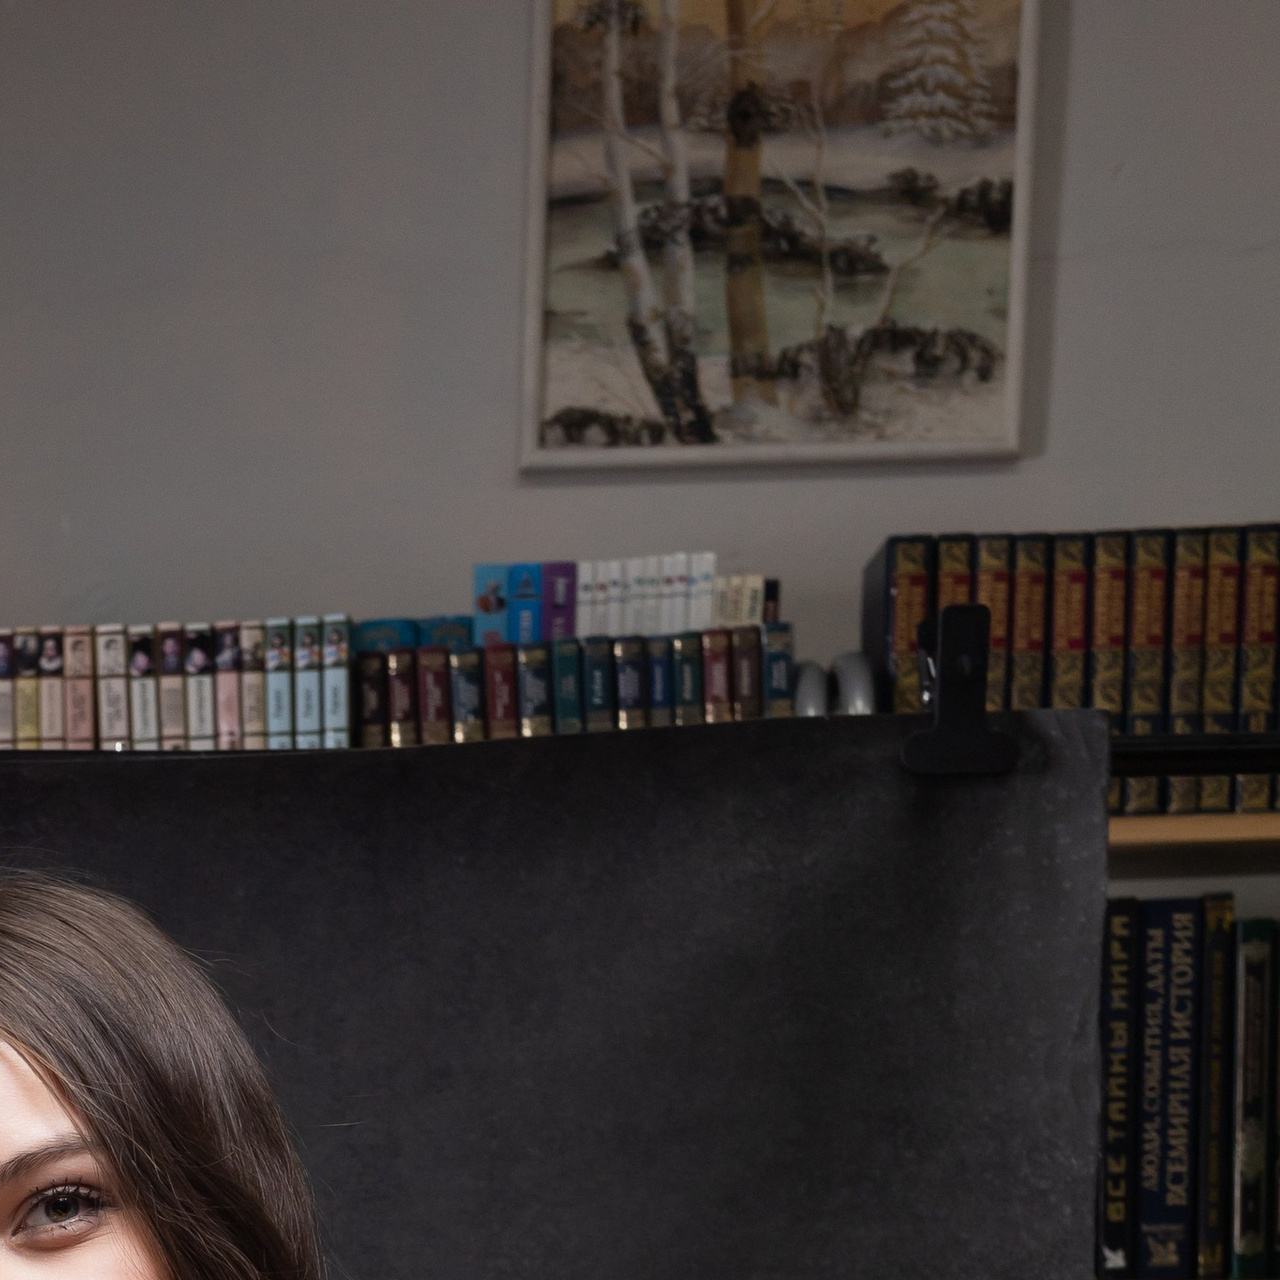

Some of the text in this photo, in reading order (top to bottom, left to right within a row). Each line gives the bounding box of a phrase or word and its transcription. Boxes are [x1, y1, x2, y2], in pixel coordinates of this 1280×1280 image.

[1107, 914, 1131, 1223] ВСЕ ТАЙНЫ МИРА
[1166, 912, 1195, 1206] ВСЕМИРНАЯ ИСТОРИЯ
